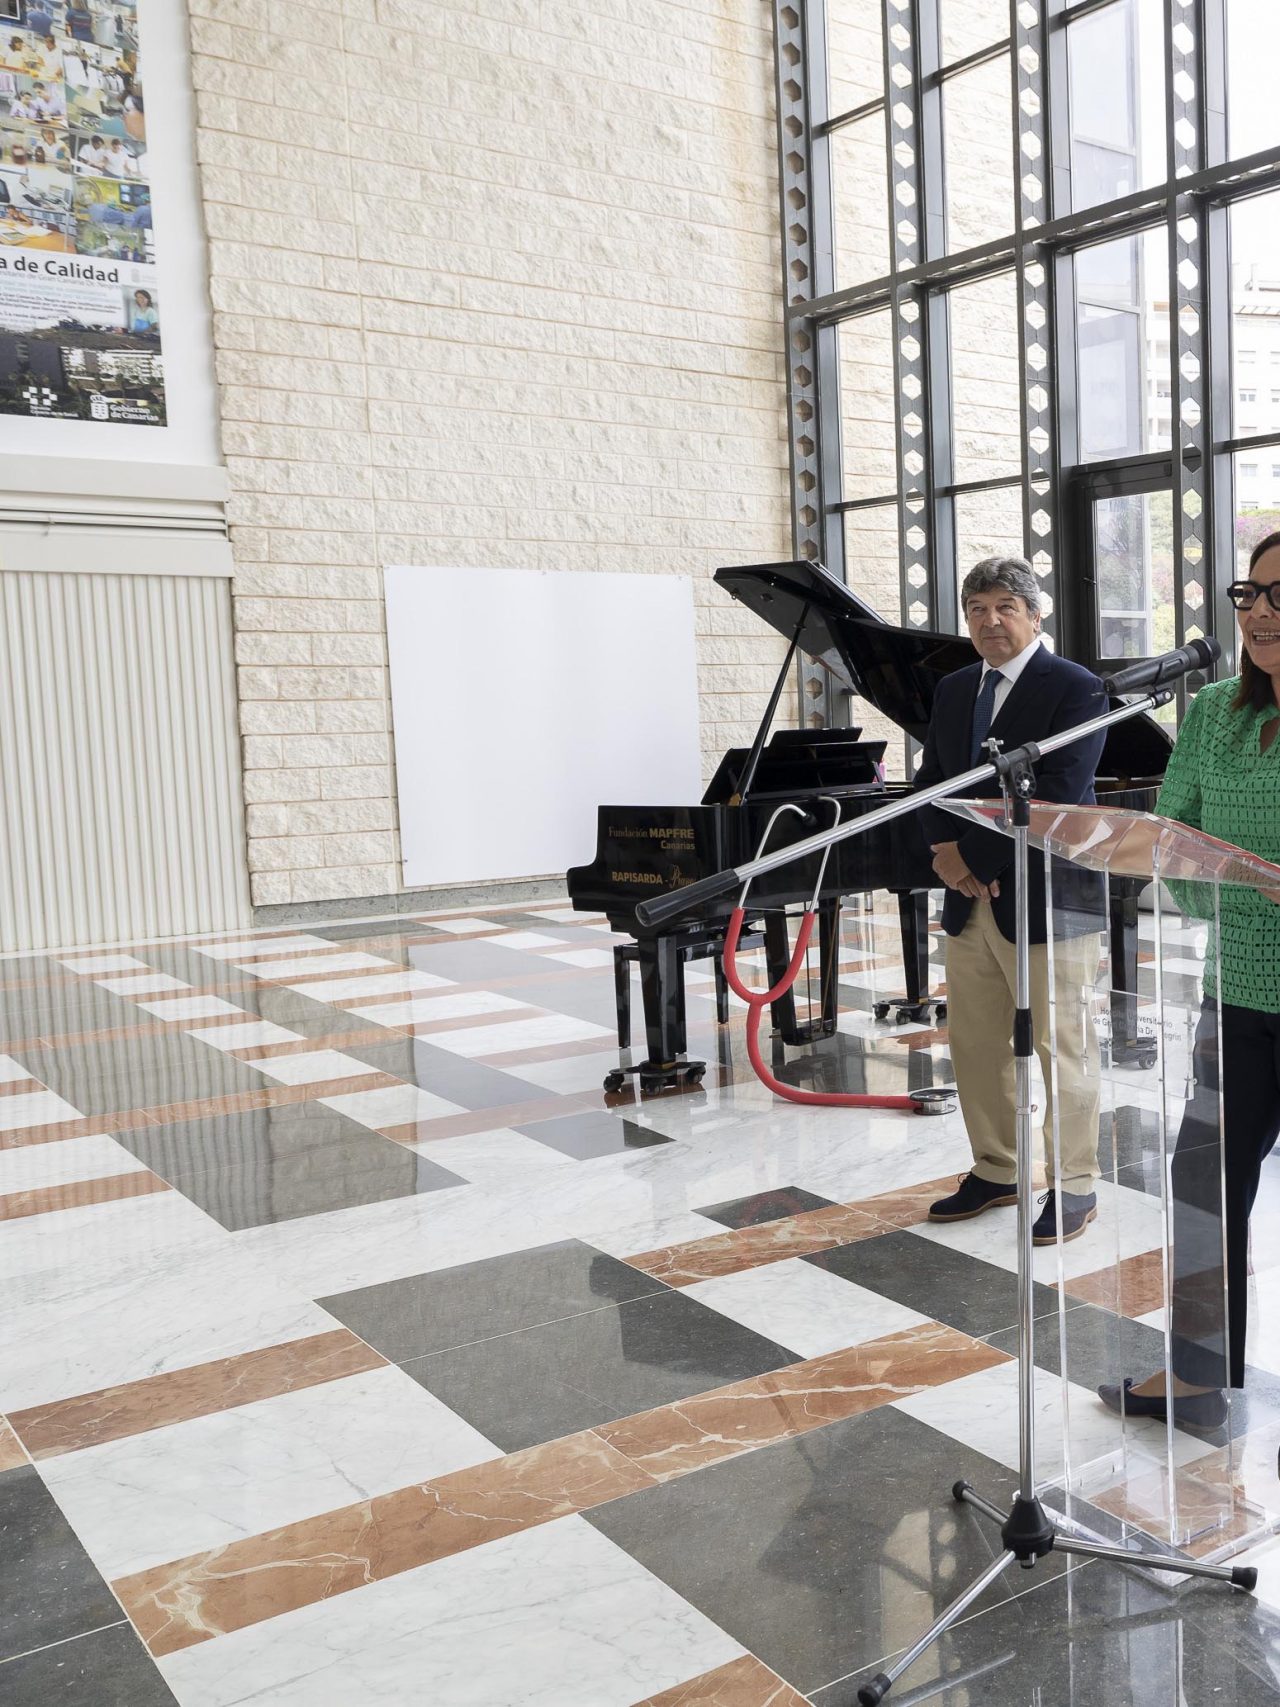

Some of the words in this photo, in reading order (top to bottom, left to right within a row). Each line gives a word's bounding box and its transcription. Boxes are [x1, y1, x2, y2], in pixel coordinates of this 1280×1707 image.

[14, 256, 39, 273] de
[45, 260, 119, 283] Calidad
[608, 826, 648, 838] Fundación
[649, 827, 695, 839] MAPFRE
[660, 840, 696, 850] Canarias
[611, 871, 663, 885] RAPISARDA
